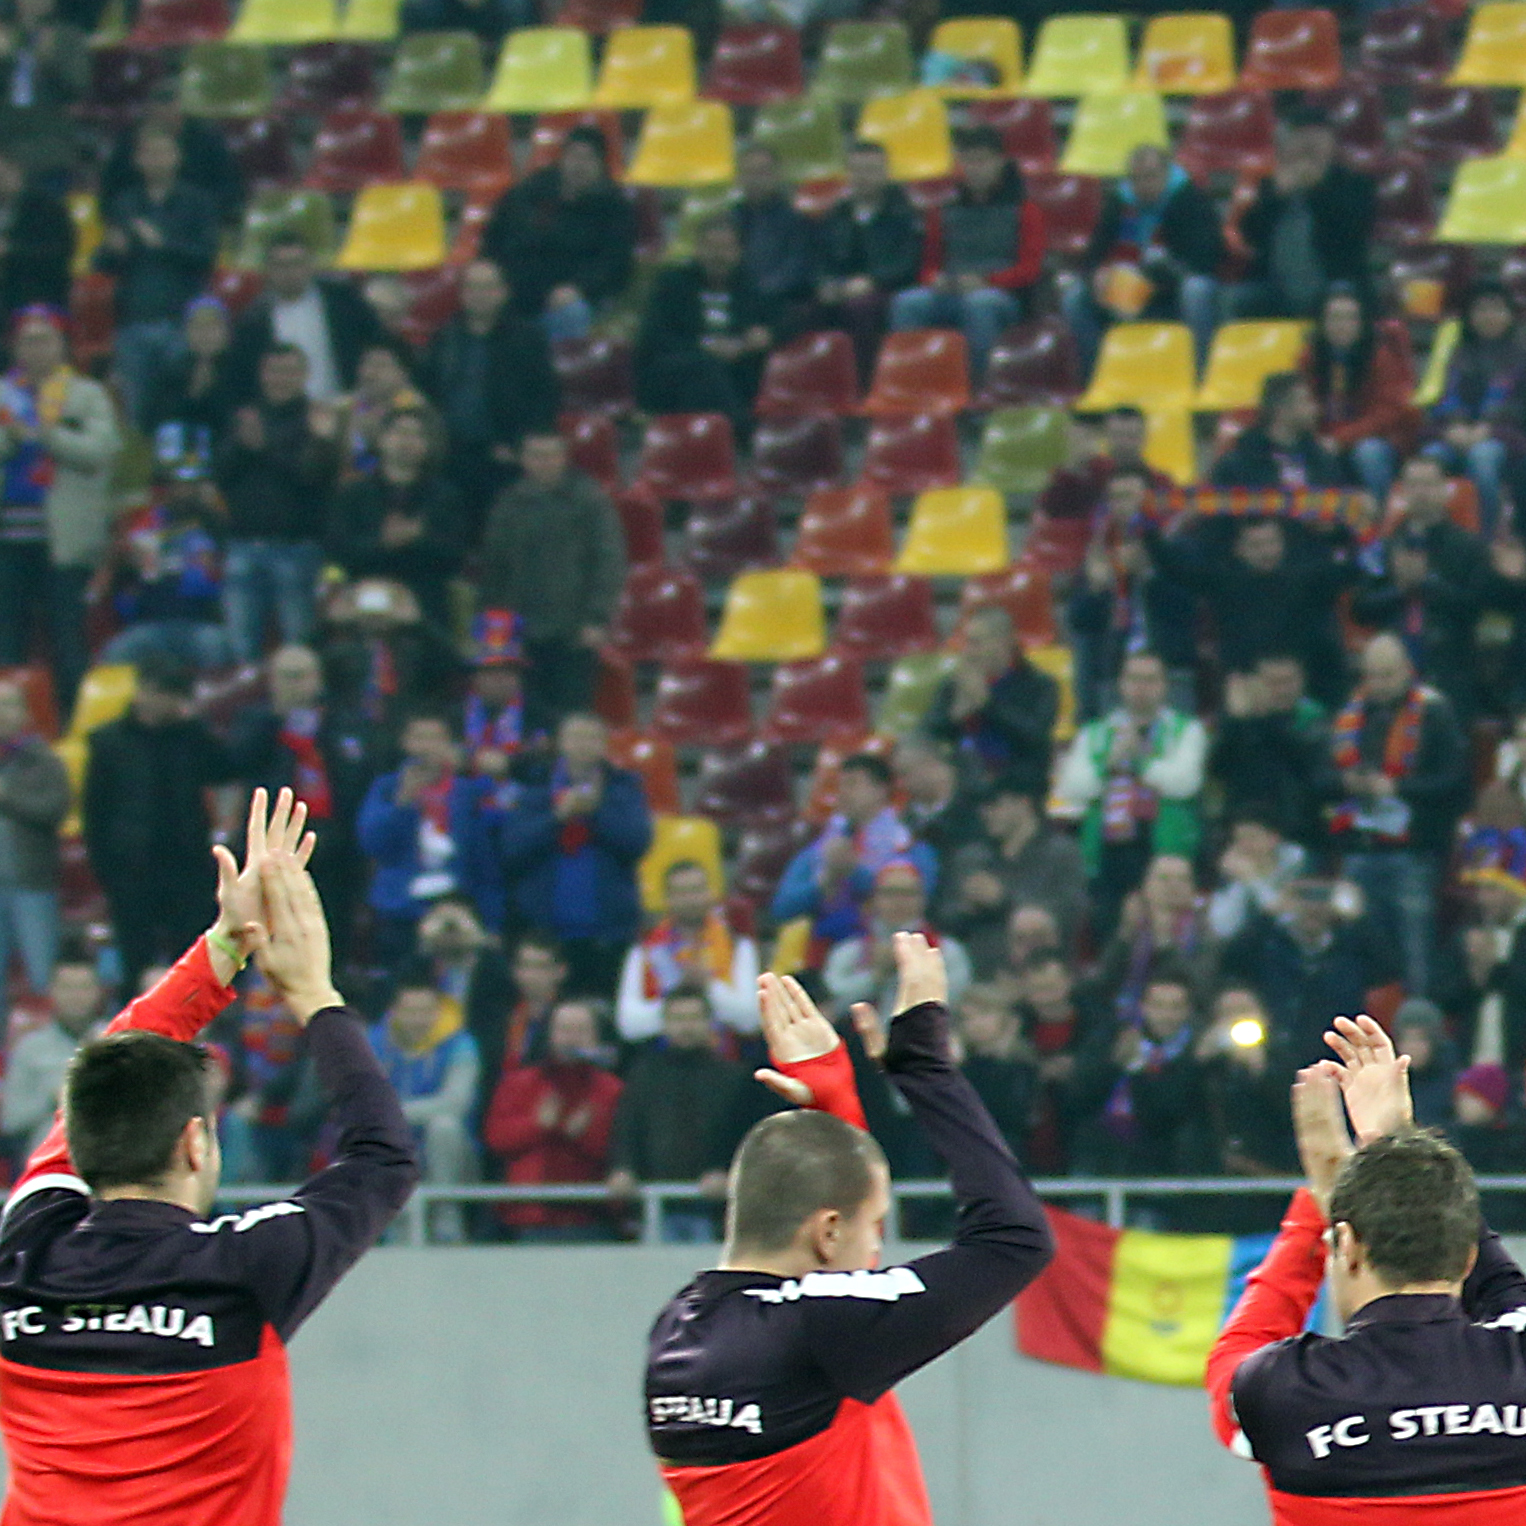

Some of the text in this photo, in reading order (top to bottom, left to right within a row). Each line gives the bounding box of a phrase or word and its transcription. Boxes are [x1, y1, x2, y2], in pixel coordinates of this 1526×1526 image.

[2, 1303, 215, 1347] FC STEAUA
[1305, 1415, 1371, 1459] FC
